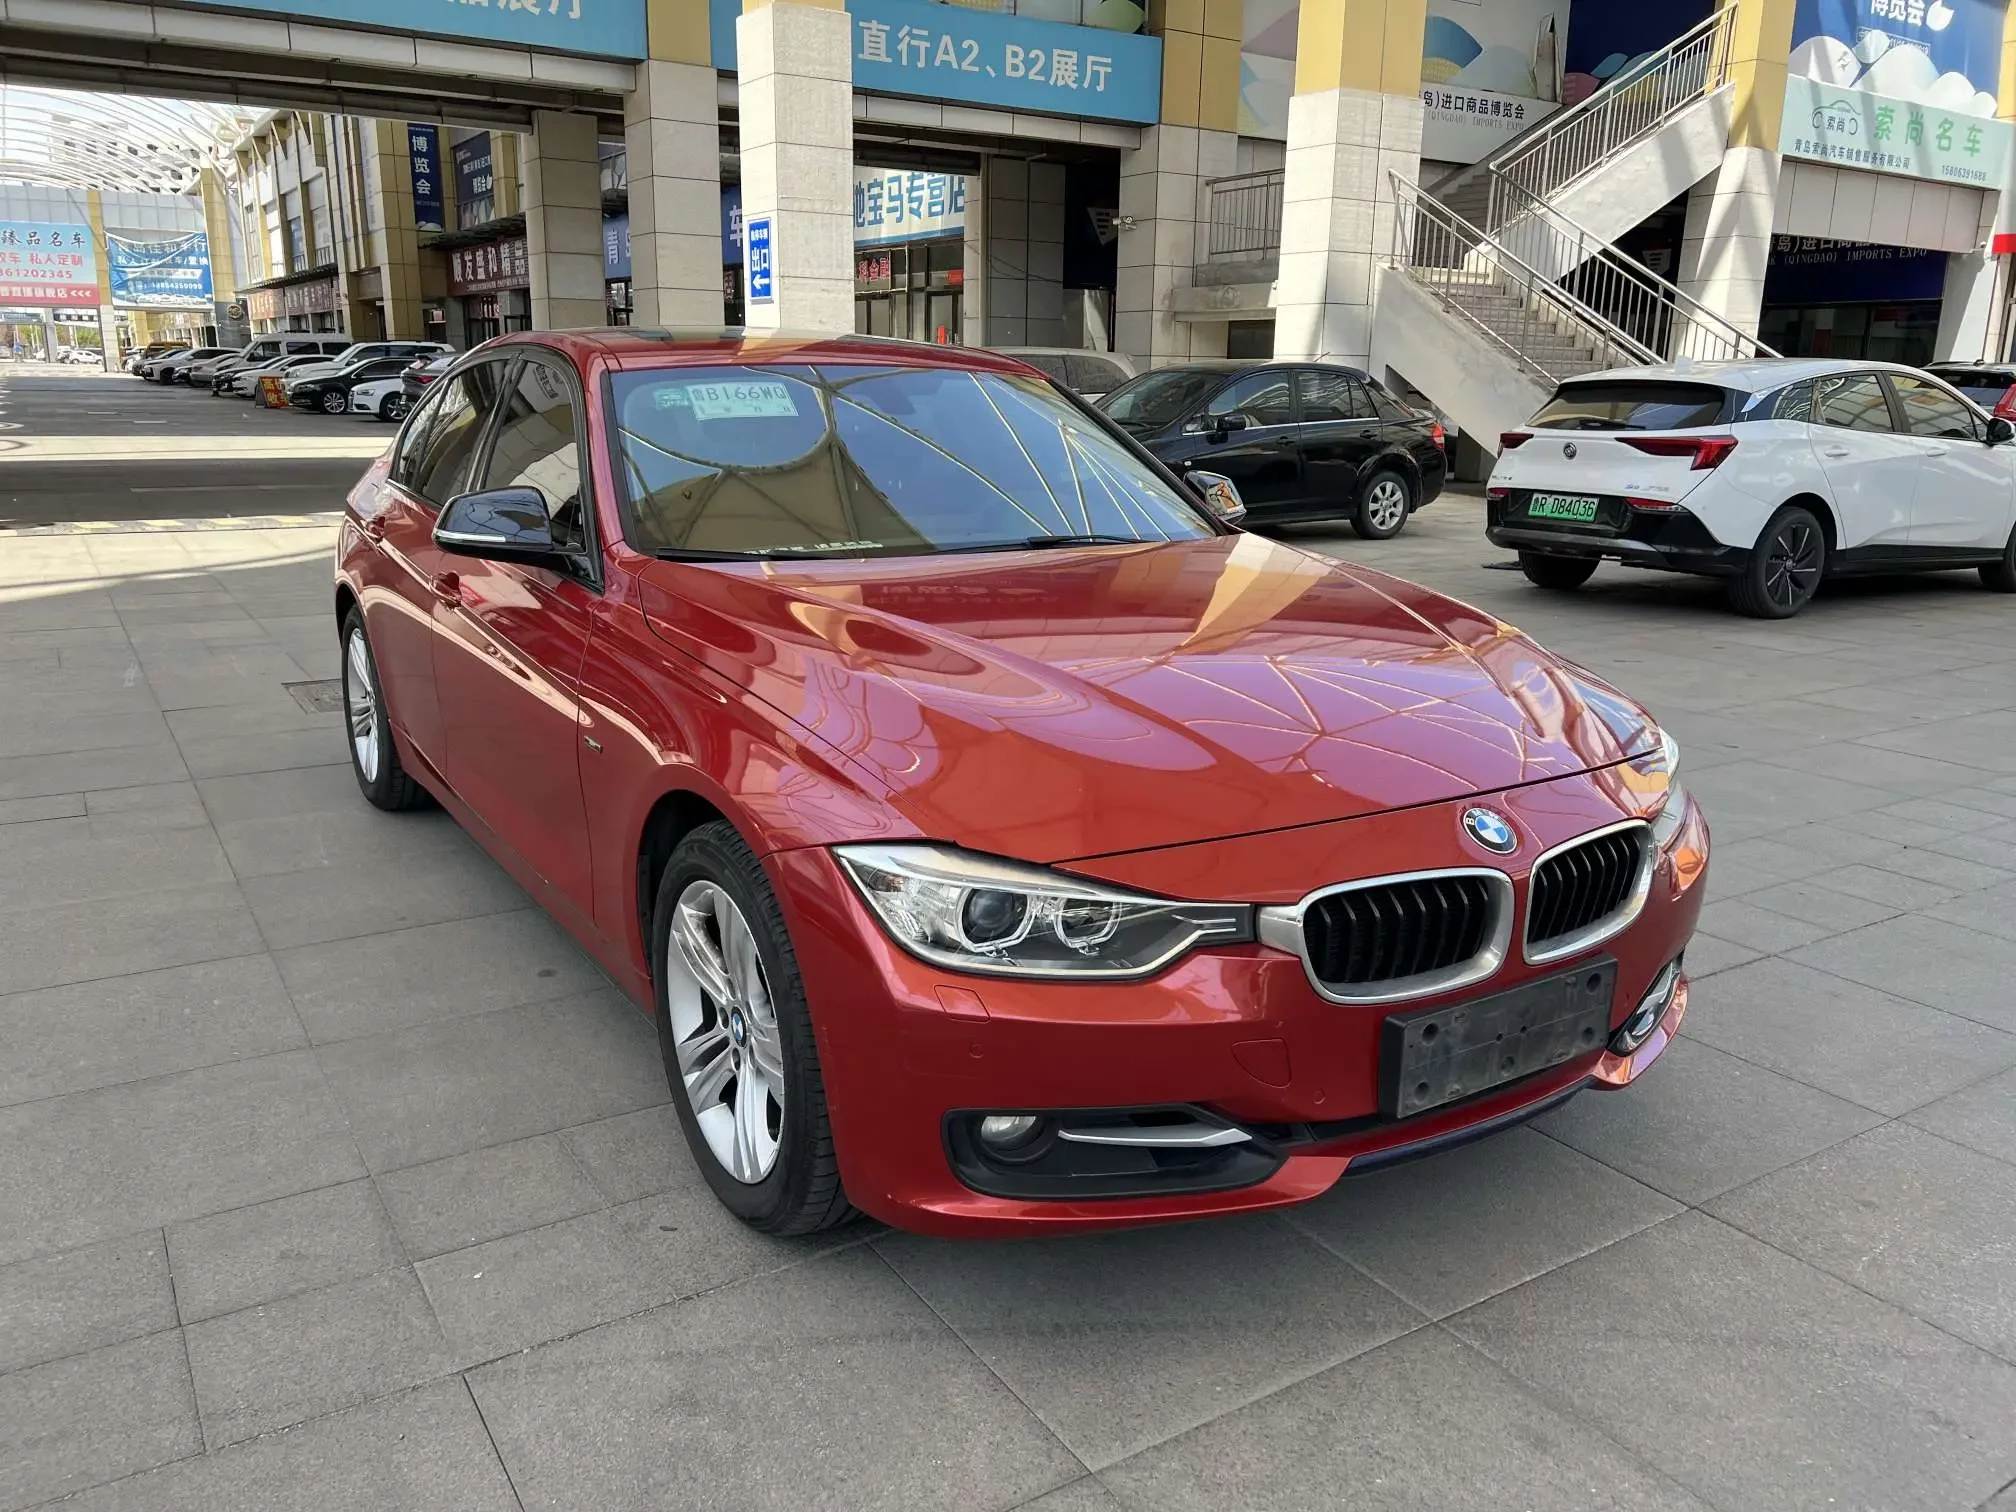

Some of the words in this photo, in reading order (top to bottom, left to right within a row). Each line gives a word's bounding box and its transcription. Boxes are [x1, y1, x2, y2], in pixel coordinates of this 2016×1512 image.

[857, 19, 1113, 92] 直行A2、B2展厅
[1826, 115, 1846, 133] 索尚
[1873, 105, 1984, 157] 索尚名车
[411, 135, 431, 195] 博览会
[29, 253, 84, 267] 私人定制
[751, 247, 769, 272] 出口
[1783, 252, 1838, 266] (QINGDAO)
[1847, 248, 1893, 261] IMPORTS
[1900, 247, 1927, 259] EXPO
[1551, 497, 1596, 517] D84036
